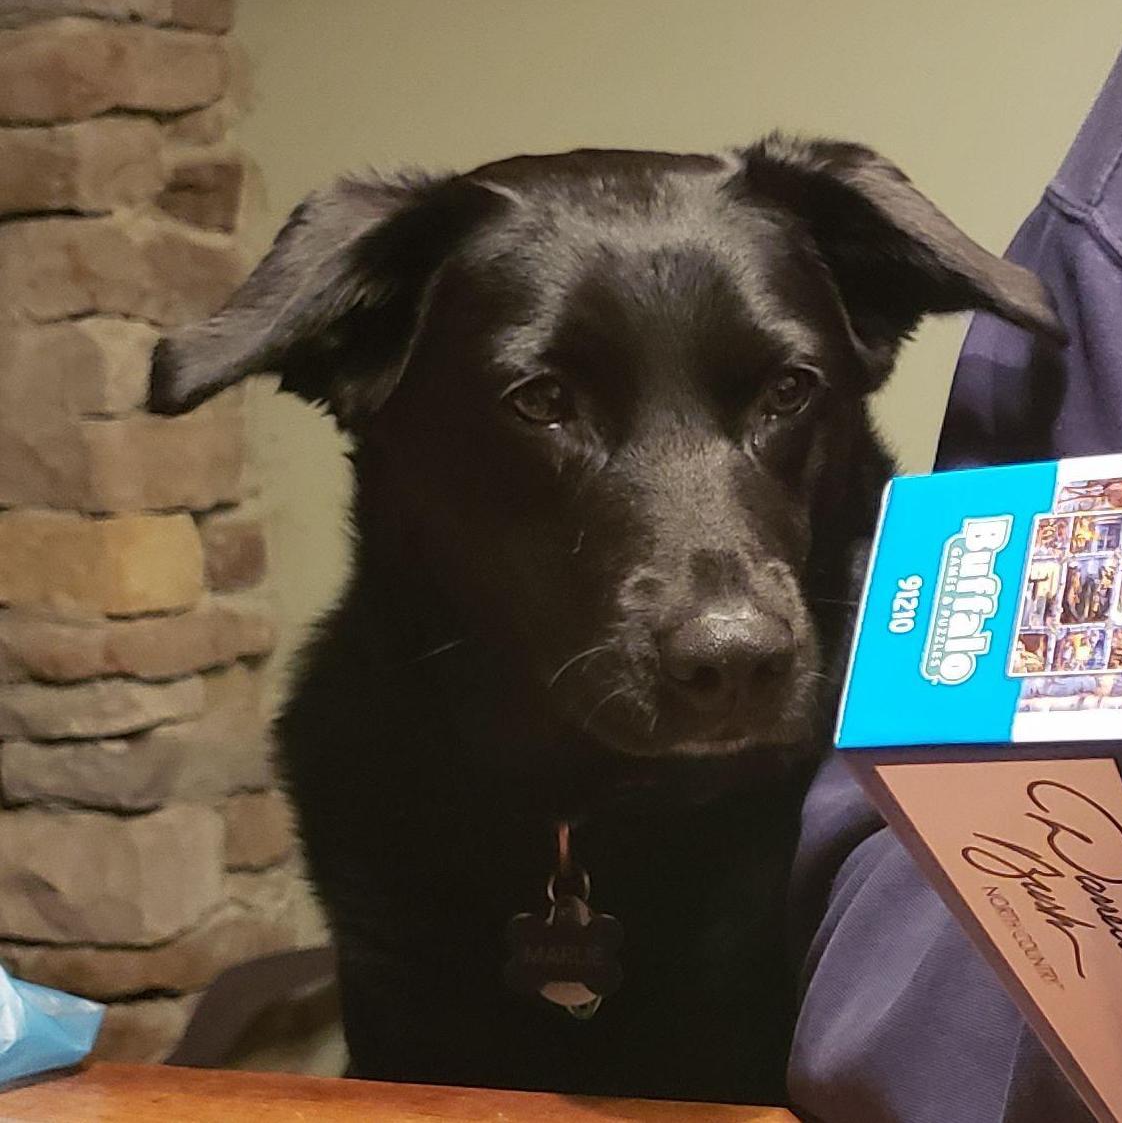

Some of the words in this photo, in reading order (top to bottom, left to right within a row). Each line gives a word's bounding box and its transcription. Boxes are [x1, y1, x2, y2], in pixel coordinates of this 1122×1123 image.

[944, 547, 963, 592] GAMES
[889, 574, 924, 634] 91210
[938, 517, 1011, 682] Buffalo
[928, 608, 951, 667] PUZZLES
